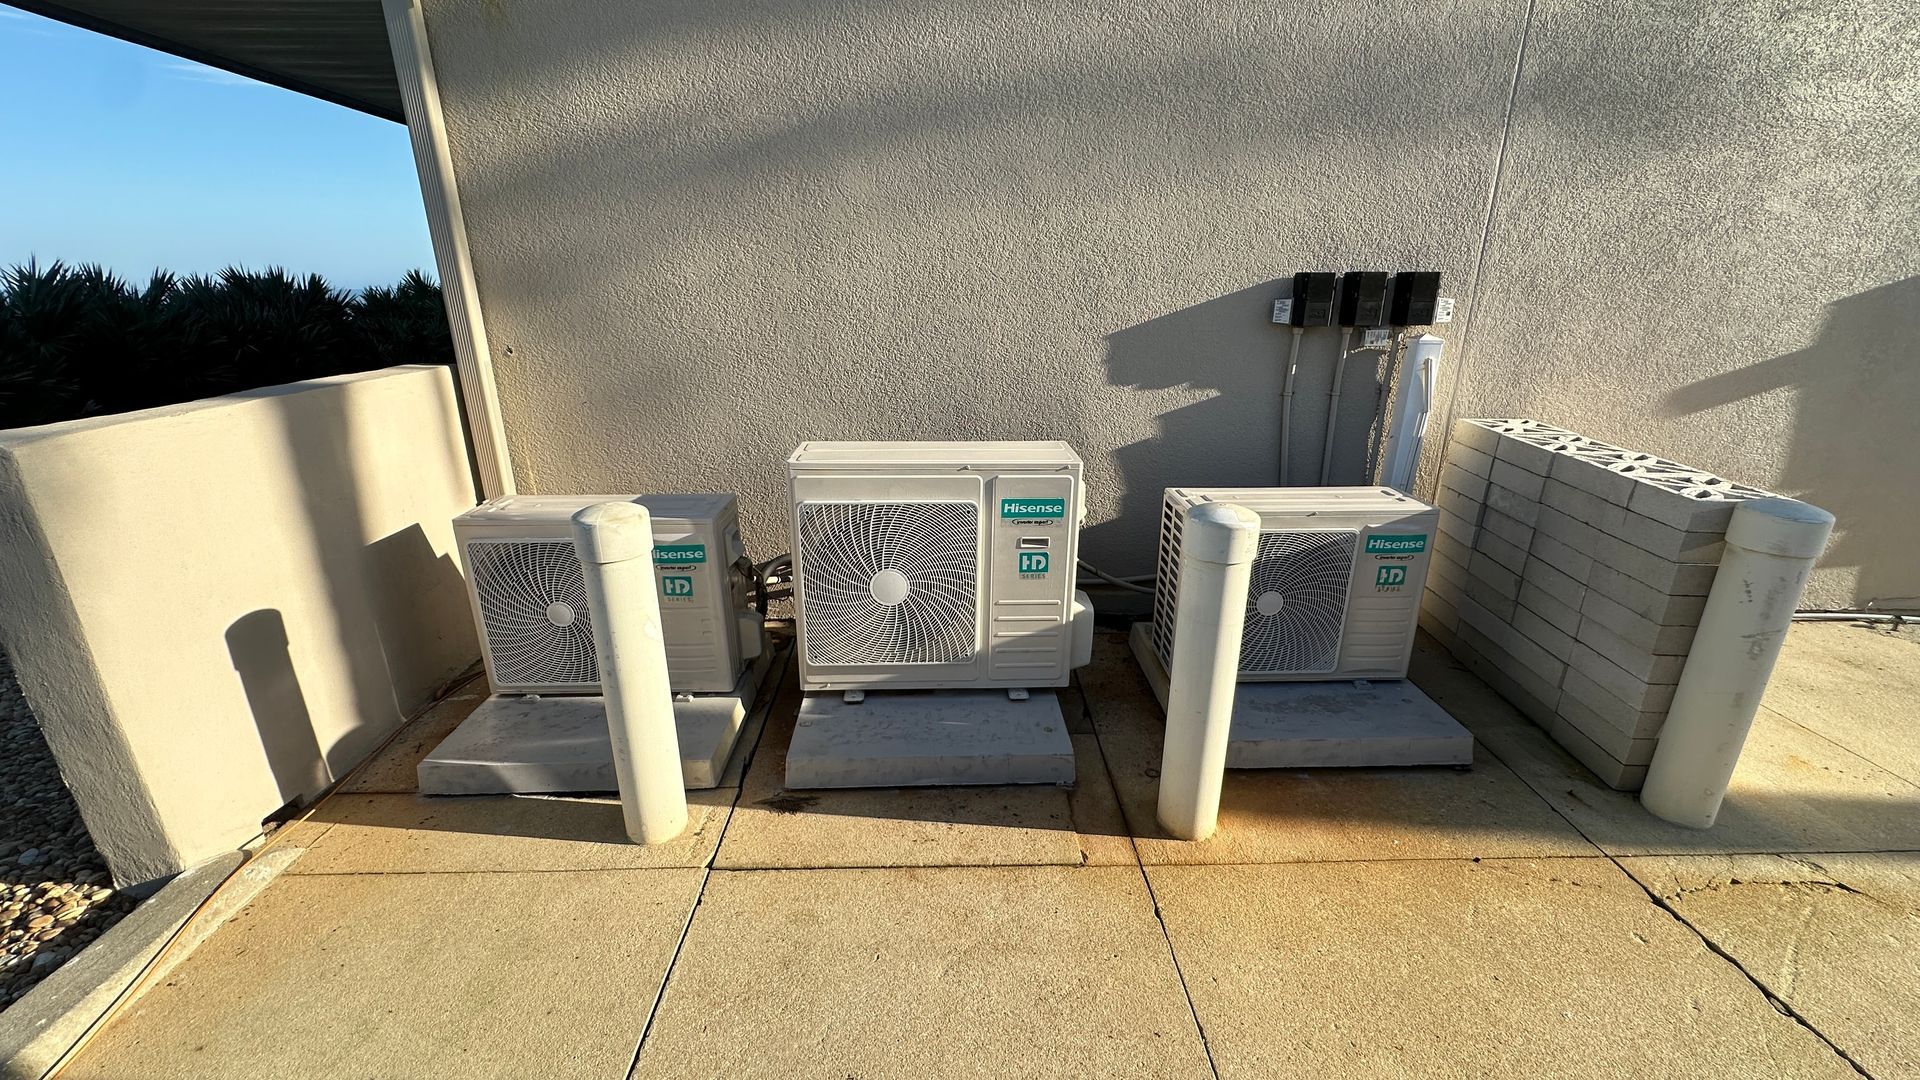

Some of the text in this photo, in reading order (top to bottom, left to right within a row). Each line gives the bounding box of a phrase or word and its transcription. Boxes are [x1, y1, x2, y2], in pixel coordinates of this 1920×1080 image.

[1004, 503, 1062, 513] Hisense
[1368, 539, 1424, 549] Hisense
[1022, 555, 1046, 570] HD
[1379, 568, 1404, 583] HD
[665, 579, 690, 594] HD
